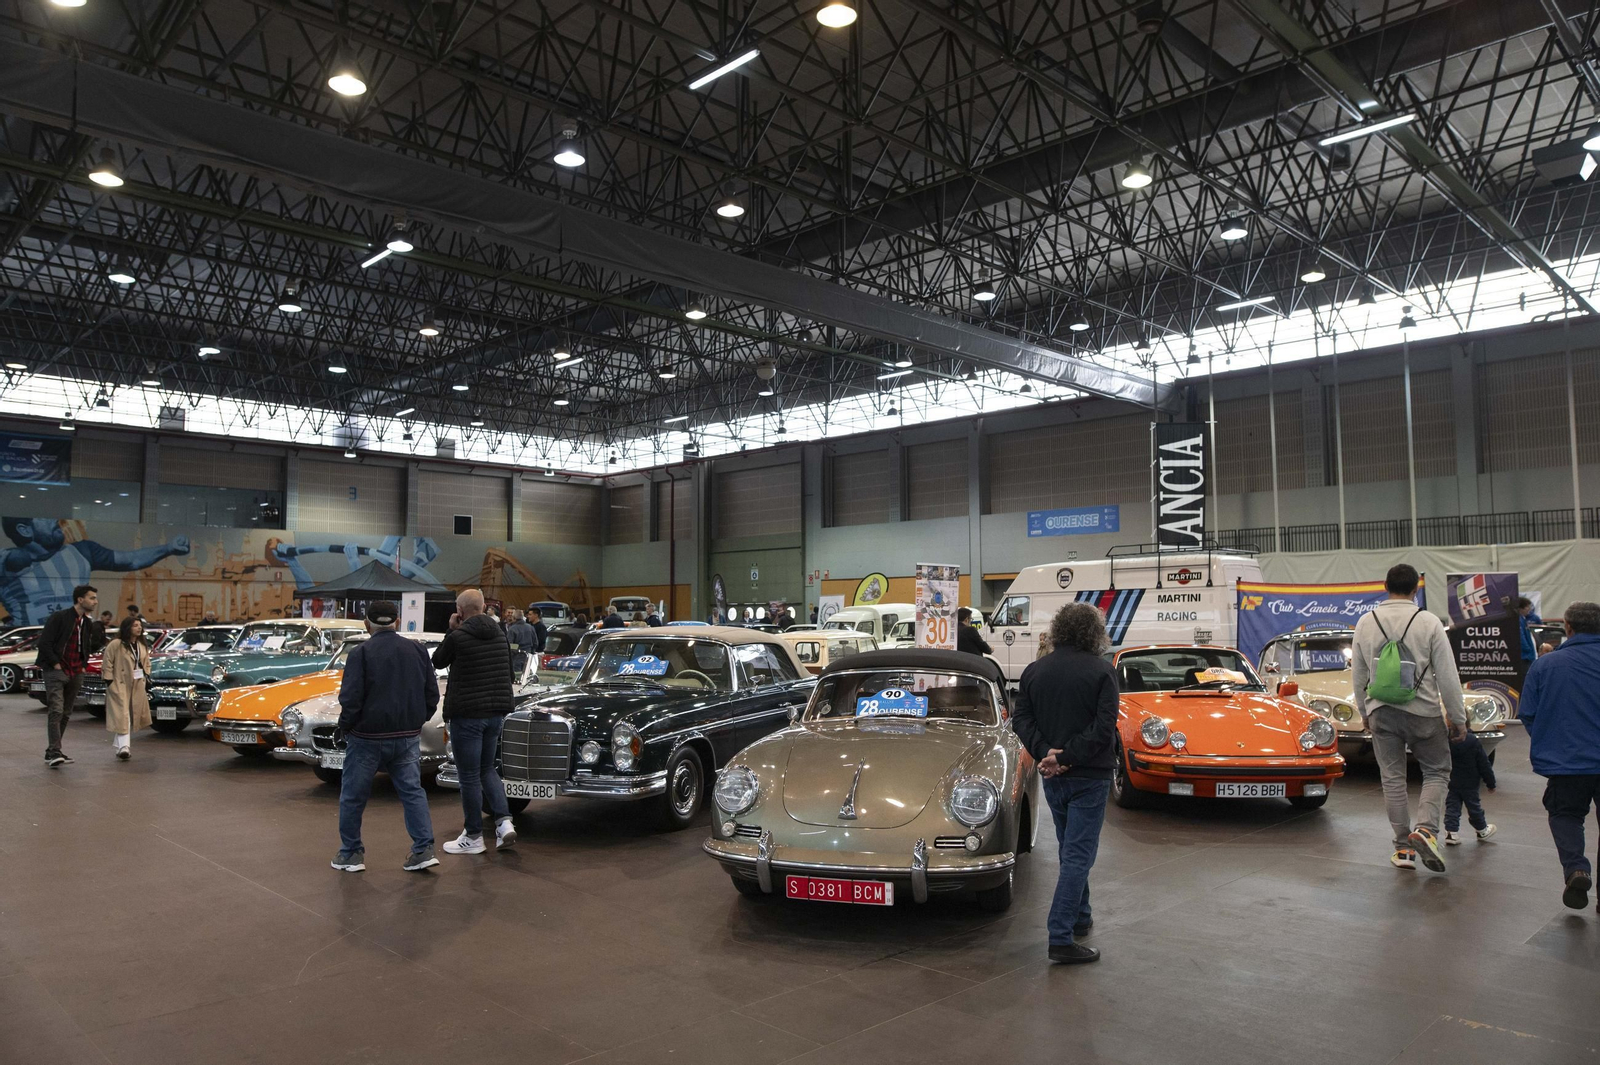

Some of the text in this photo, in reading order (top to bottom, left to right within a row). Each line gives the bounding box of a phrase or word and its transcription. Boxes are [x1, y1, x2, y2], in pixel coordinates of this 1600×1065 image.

[1159, 433, 1204, 551] LANCIA
[1045, 513, 1100, 529] OURENSE
[1168, 572, 1201, 580] MARTINI
[1157, 593, 1201, 603] MARTINI
[1267, 599, 1382, 617] Club Lancia Españ
[1157, 611, 1197, 621] RACING
[926, 617, 948, 645] 30
[1466, 626, 1501, 637] CLUB
[1461, 639, 1508, 649] LANCIA
[1312, 653, 1344, 663] LANCIA
[1459, 651, 1511, 662] ESPAÑA
[619, 663, 635, 675] 28
[885, 690, 902, 698] 90
[859, 700, 923, 716] 28 OURENSE
[506, 783, 553, 798] 8394 BBC
[1261, 784, 1284, 796] BBH
[790, 880, 798, 894] S
[808, 881, 842, 898] 0381
[854, 885, 882, 900] BCM
